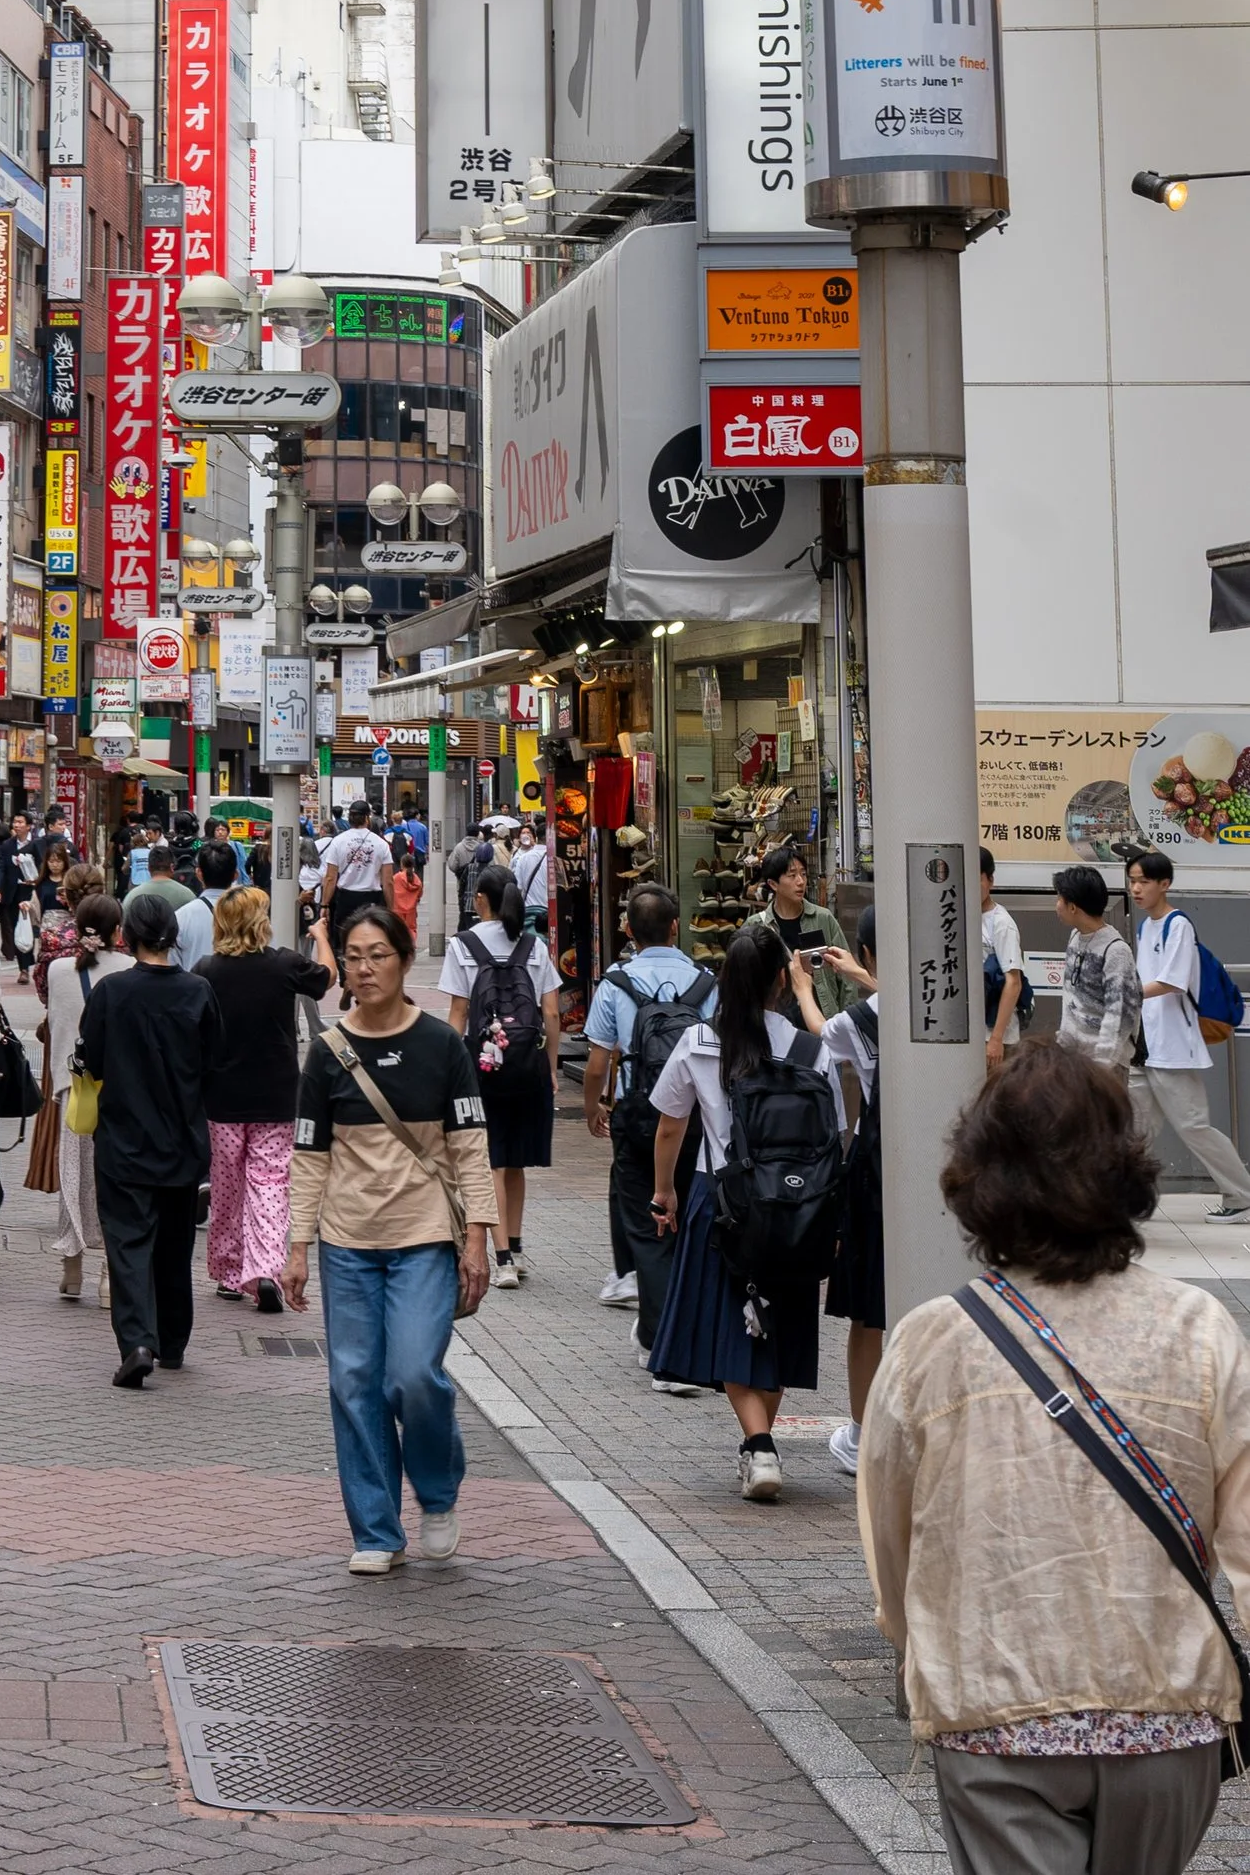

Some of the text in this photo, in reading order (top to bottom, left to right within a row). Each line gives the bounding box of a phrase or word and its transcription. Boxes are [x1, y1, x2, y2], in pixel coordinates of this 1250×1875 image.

[845, 54, 990, 72] Litterers will be fined.
[880, 77, 918, 88] Starts
[922, 76, 948, 87] June
[54, 60, 68, 149] モニタールーム
[909, 106, 964, 125] 渋谷区
[910, 127, 964, 138] Shibuya City
[184, 21, 212, 277] カラオケ歌広
[460, 147, 513, 172] 渋谷
[717, 306, 850, 329] Ventuno Tokyo
[751, 332, 820, 342] シブヤショクドウ
[179, 386, 330, 406] 渋谷センター街
[752, 395, 825, 407] 中国料理
[50, 422, 75, 433] 3F
[109, 280, 154, 631] カラオケ歌広場
[51, 556, 72, 569] 2F
[368, 550, 460, 563] 渋谷センター街
[182, 594, 256, 604] 渋谷センター街
[51, 622, 70, 663] 松屋
[149, 645, 178, 659] 消火栓
[979, 729, 1166, 748] スウェーデンレストラン
[981, 824, 1061, 842] 7階 180席
[1224, 830, 1250, 838] IKE
[940, 885, 960, 1000] バスケットボール
[920, 959, 938, 1031] ストリート
